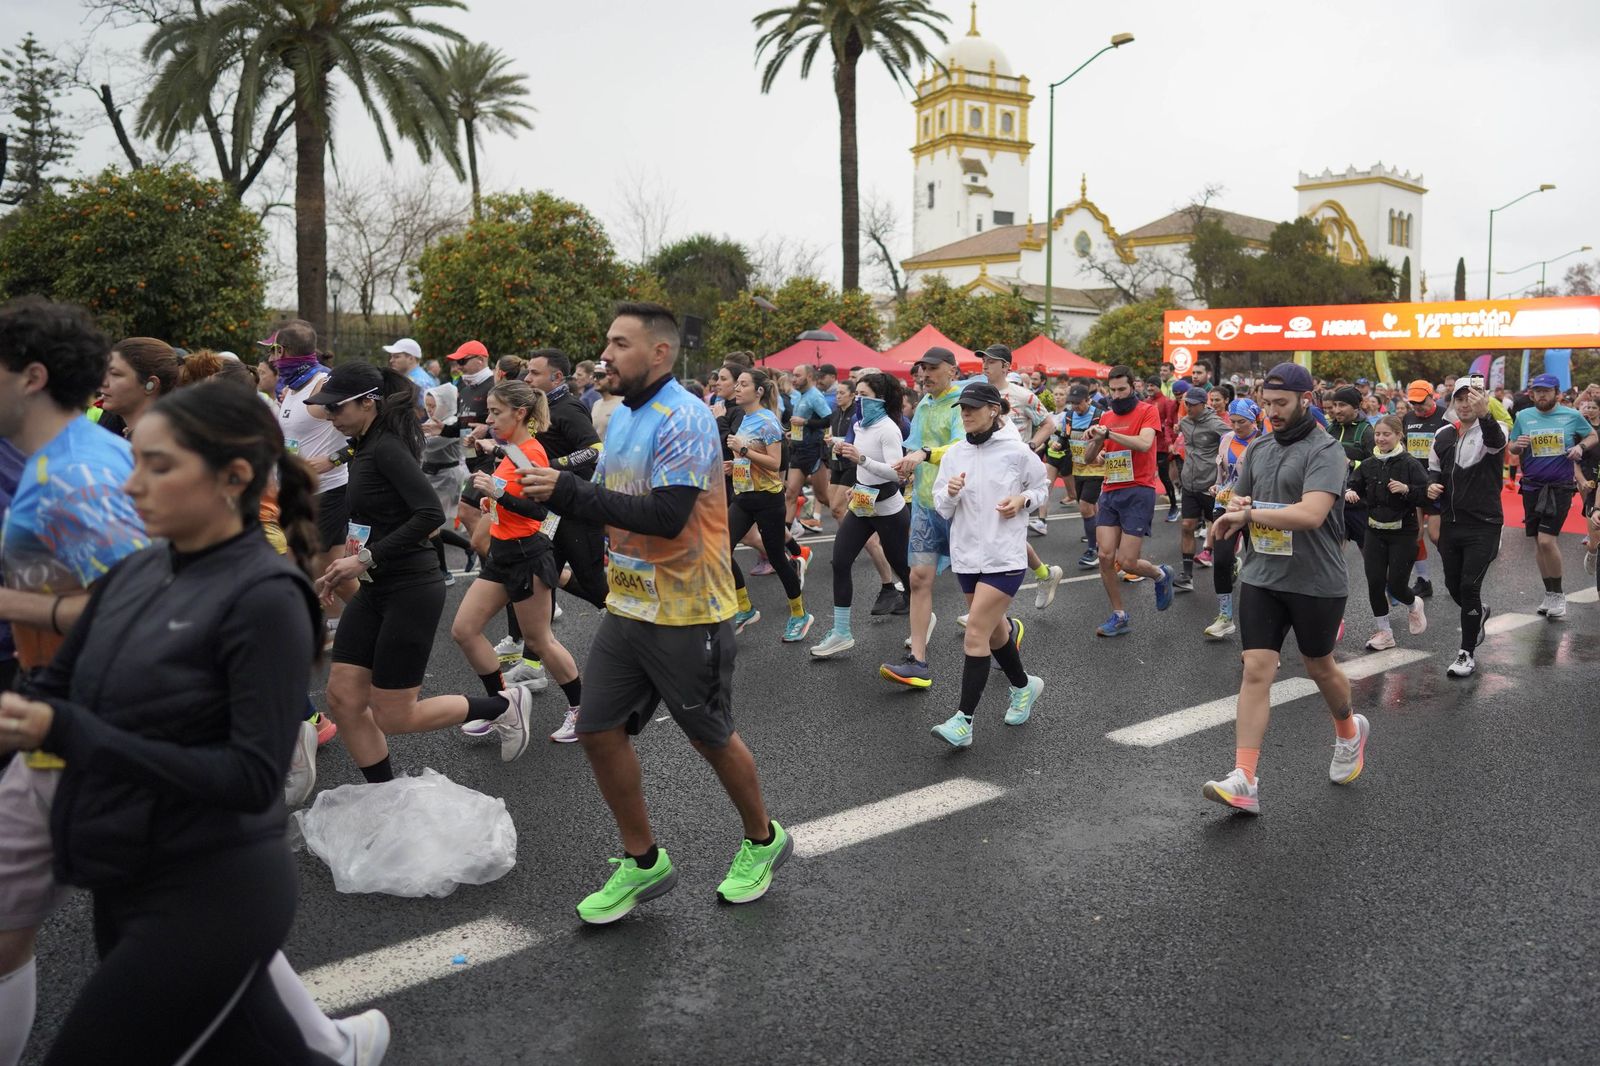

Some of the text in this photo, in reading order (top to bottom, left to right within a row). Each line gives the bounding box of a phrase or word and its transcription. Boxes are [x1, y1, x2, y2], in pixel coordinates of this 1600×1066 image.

[1408, 439, 1429, 447] 18670
[1533, 435, 1559, 445] 18671
[1107, 458, 1127, 469] 18244
[610, 567, 645, 592] 18841
